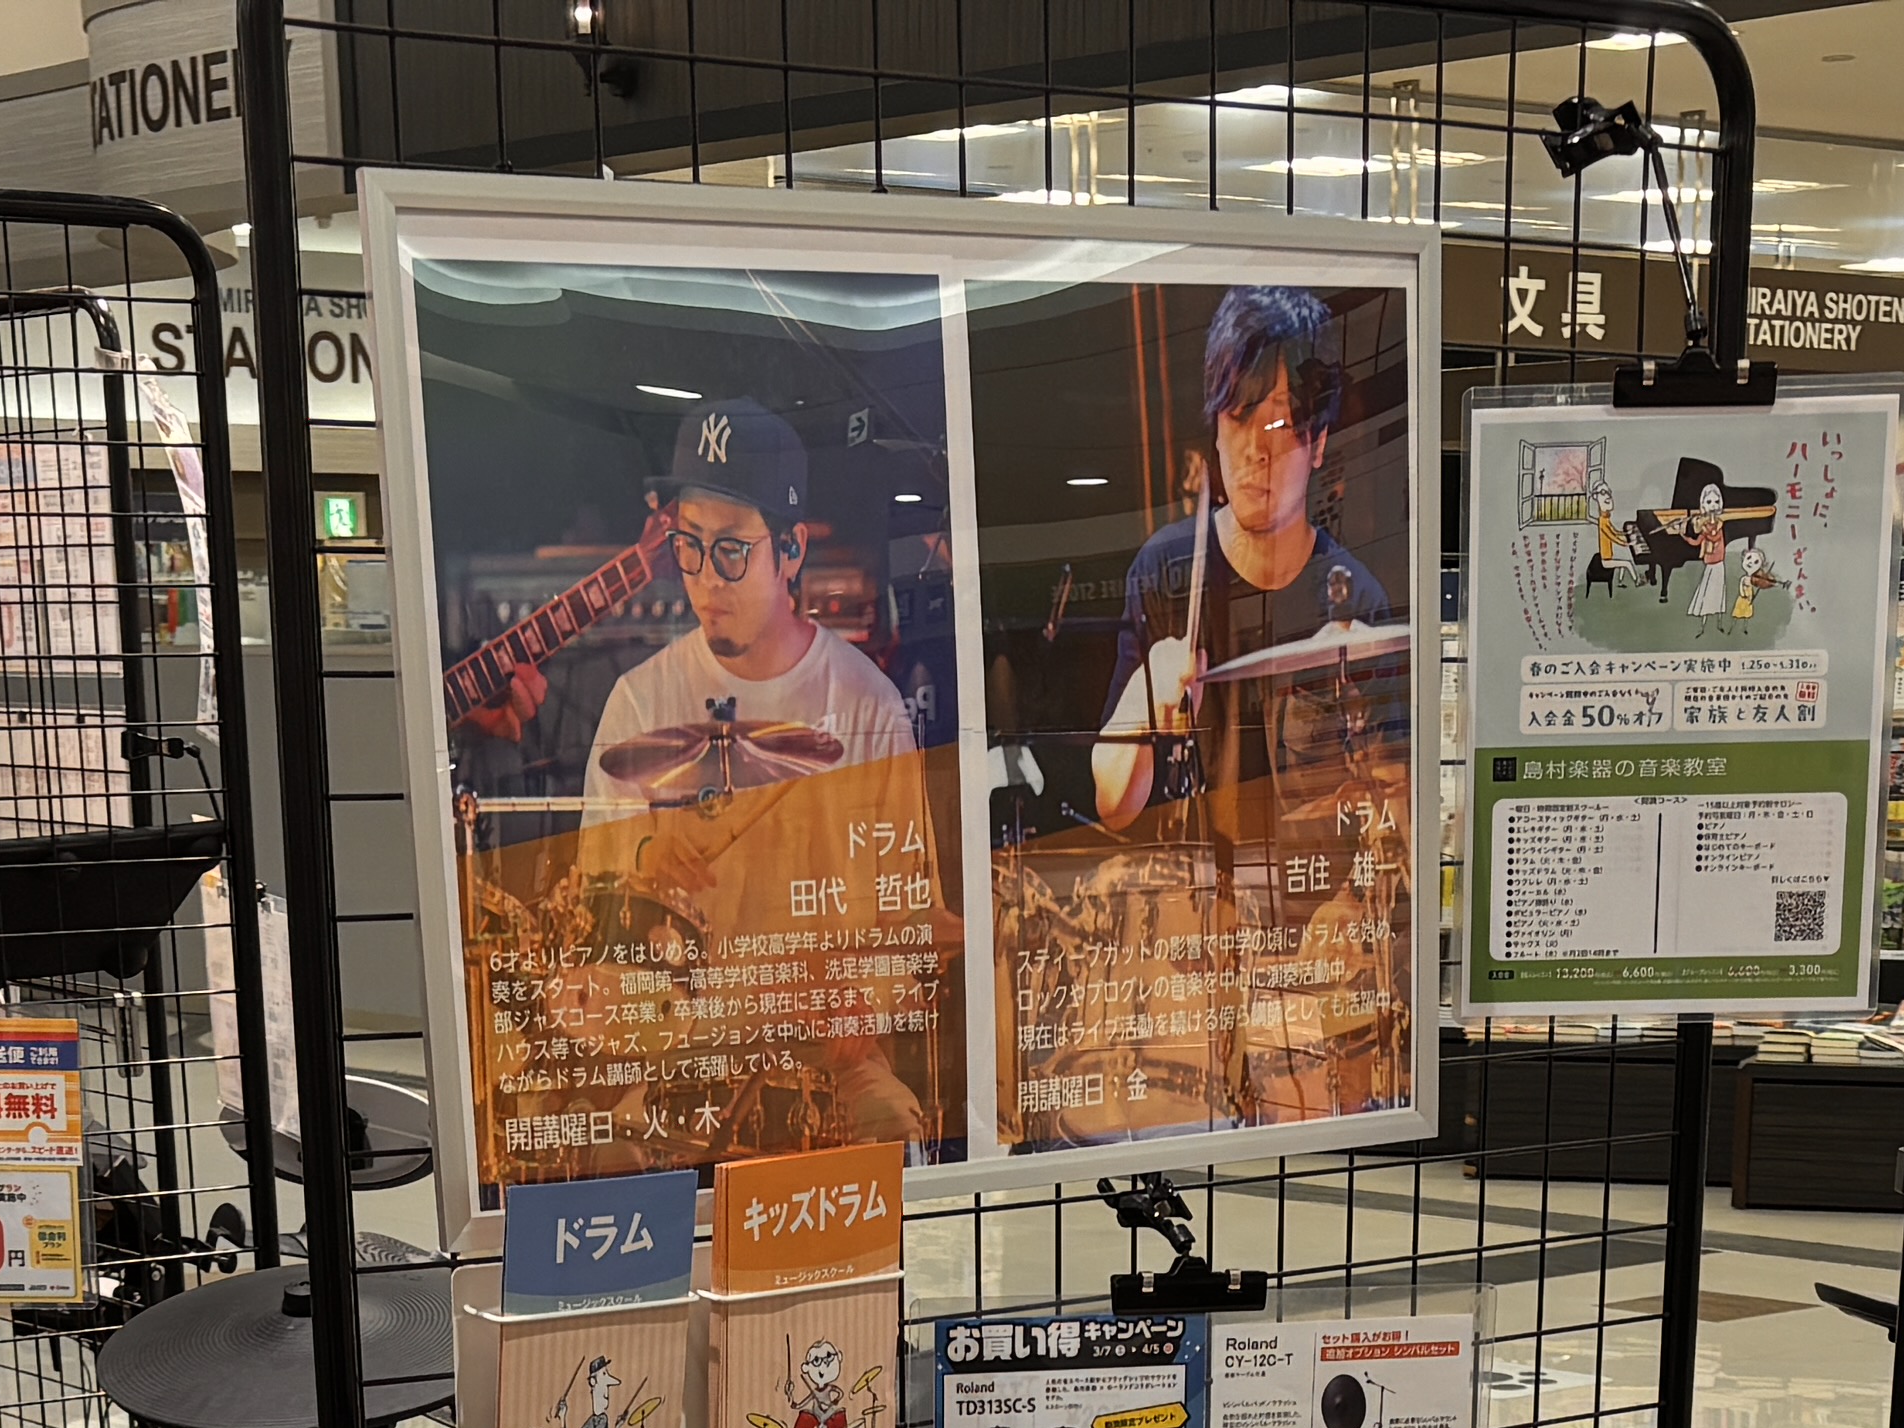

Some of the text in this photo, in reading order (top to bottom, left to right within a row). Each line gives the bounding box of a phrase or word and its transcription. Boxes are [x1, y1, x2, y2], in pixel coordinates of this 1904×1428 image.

[1498, 265, 1608, 340] 文具
[1528, 657, 1732, 676] 春のご入会キャンペーン実施中
[1683, 704, 1818, 725] 家族と友人割
[1521, 756, 1729, 781] 島村楽器の音楽教室
[1335, 798, 1398, 837] ドラム
[846, 820, 926, 860] ドラム
[1285, 850, 1398, 894] 吉住 雄一
[790, 873, 932, 917] 田代 哲也
[498, 1051, 806, 1095] ながらドラム講師として活躍している。
[742, 1179, 888, 1242] キッズドラム
[555, 1211, 655, 1264] ドラム
[7, 1248, 26, 1268] 円
[773, 1264, 856, 1286] ミュージックスクール
[946, 1319, 1184, 1363] お買い得 キャンペーン
[1225, 1336, 1278, 1351] Roland
[1224, 1353, 1294, 1368] CY-12C-T
[955, 1381, 995, 1395] Roland
[955, 1397, 1036, 1416] TD313SC-S
